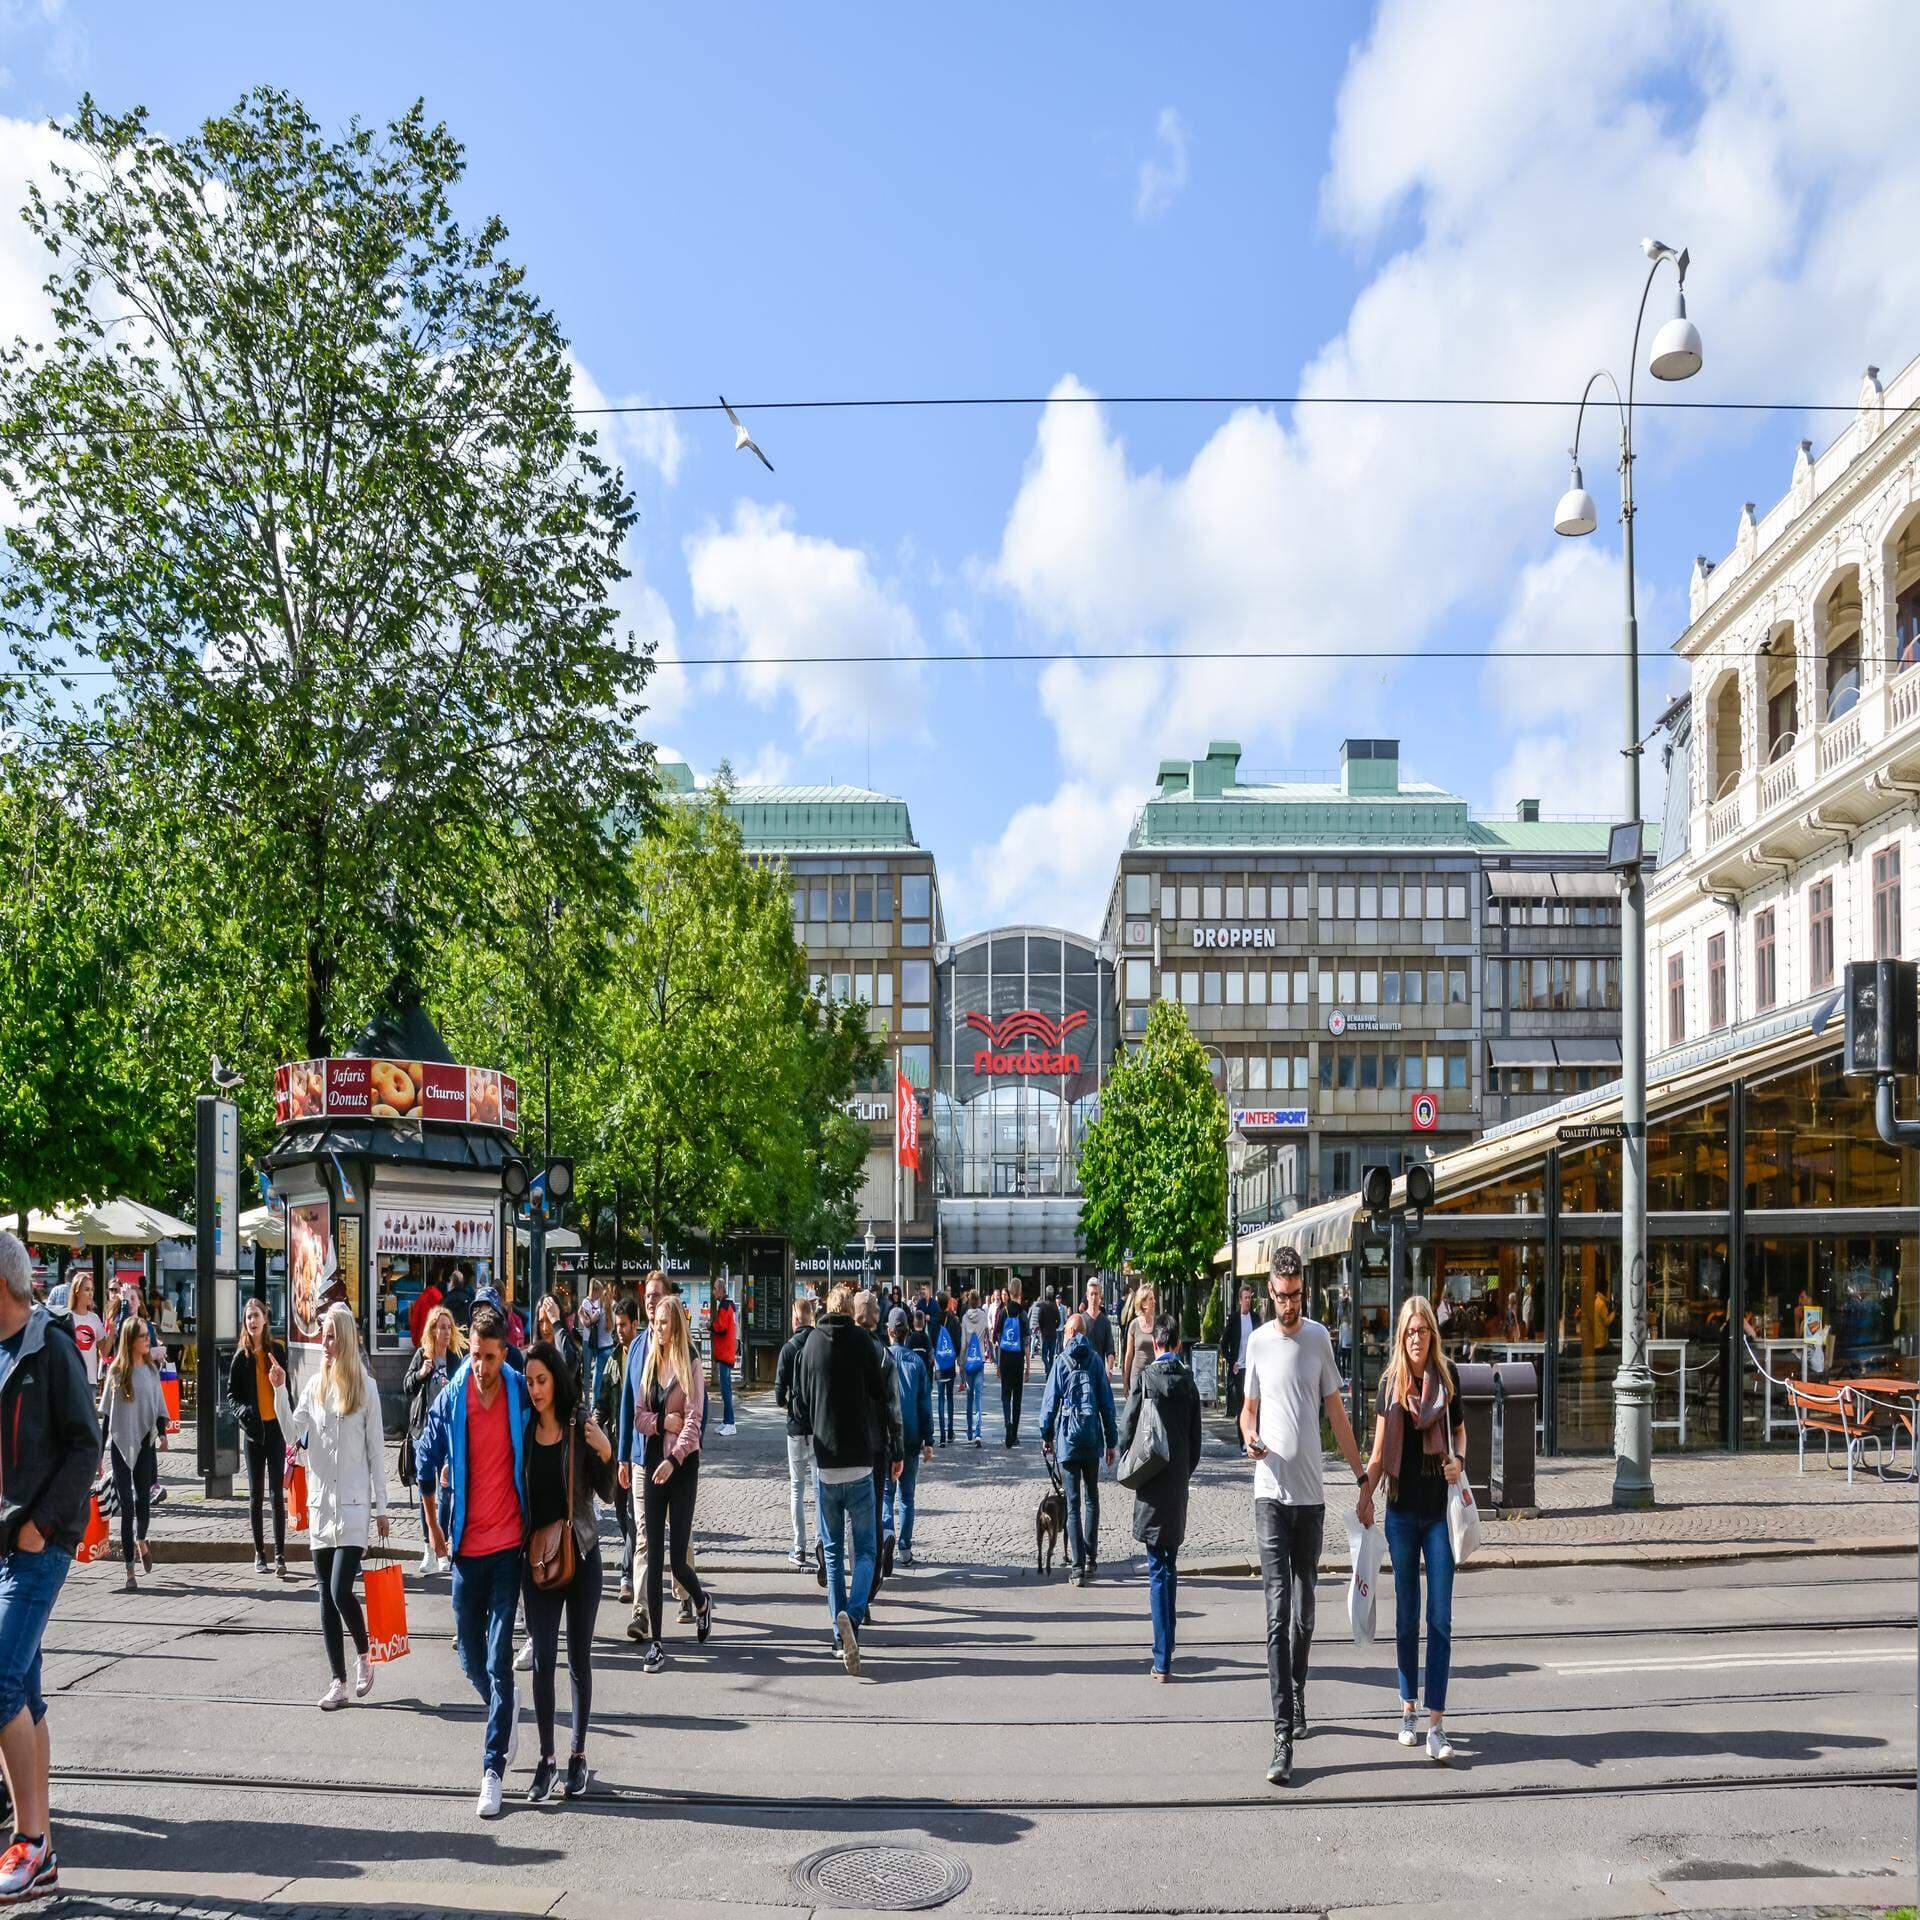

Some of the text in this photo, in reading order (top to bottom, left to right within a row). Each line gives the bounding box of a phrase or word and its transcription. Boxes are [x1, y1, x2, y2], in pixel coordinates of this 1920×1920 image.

[1193, 928, 1275, 947] DROPPEN
[332, 1067, 366, 1087] Jafaris
[329, 1090, 369, 1107] Donuts
[426, 1084, 465, 1101] Churros
[1245, 1111, 1306, 1125] INTERSPORT
[1561, 1128, 1590, 1138] TOALETT
